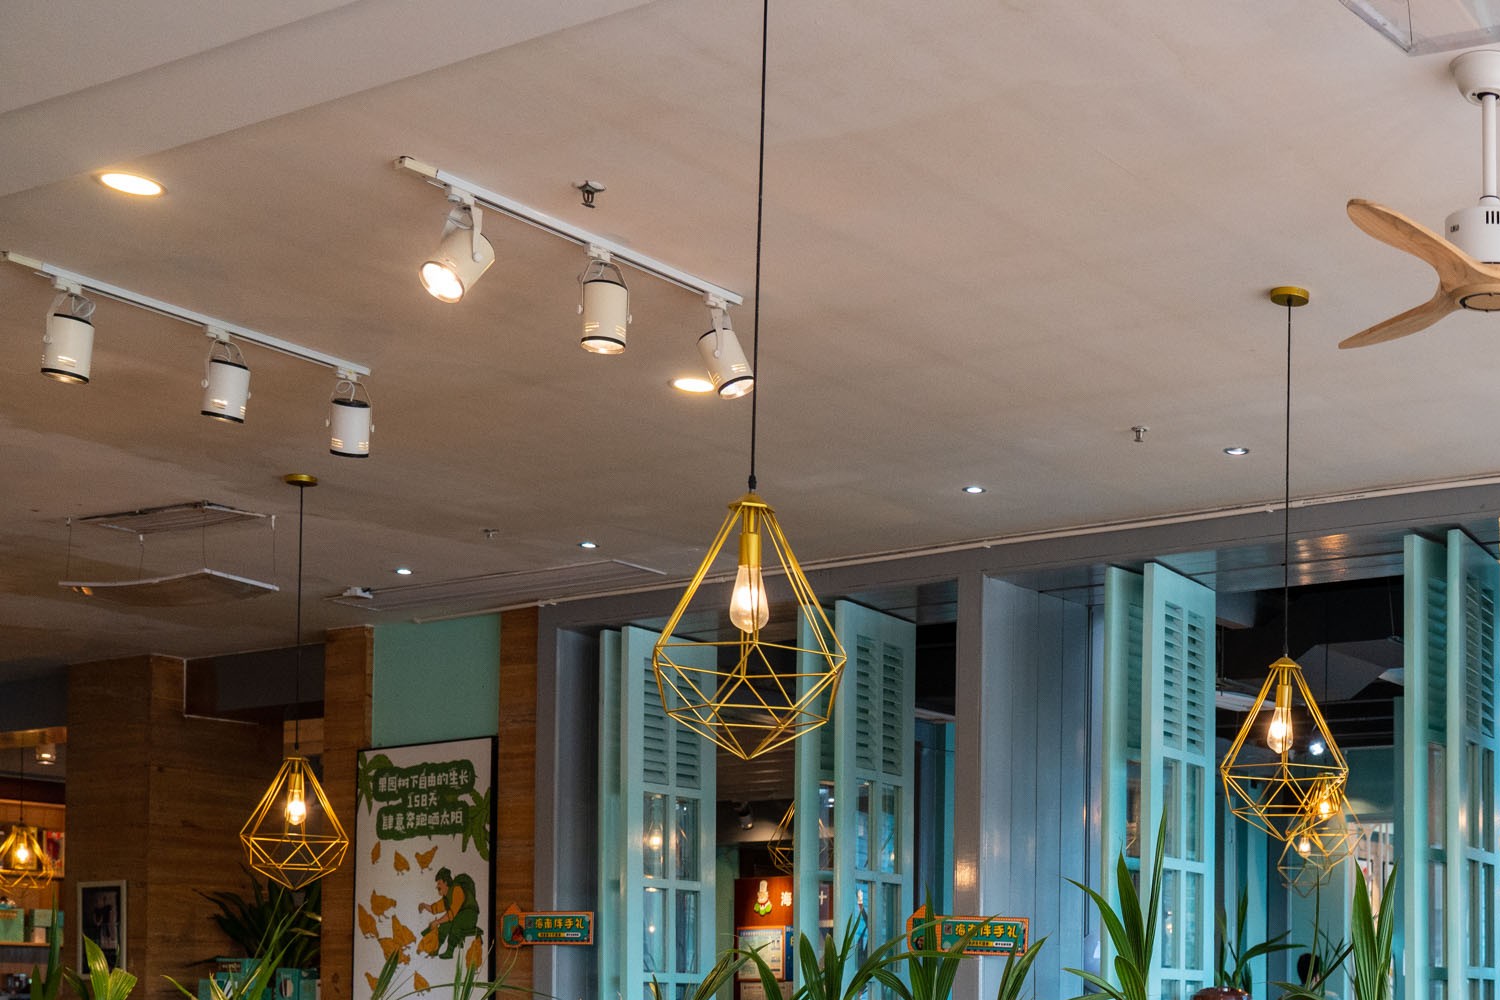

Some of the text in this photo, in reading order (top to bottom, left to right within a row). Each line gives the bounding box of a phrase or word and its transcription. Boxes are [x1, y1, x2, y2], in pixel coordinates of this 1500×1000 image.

[378, 769, 469, 792] 果园树下自由的生长
[407, 792, 438, 808] 158天
